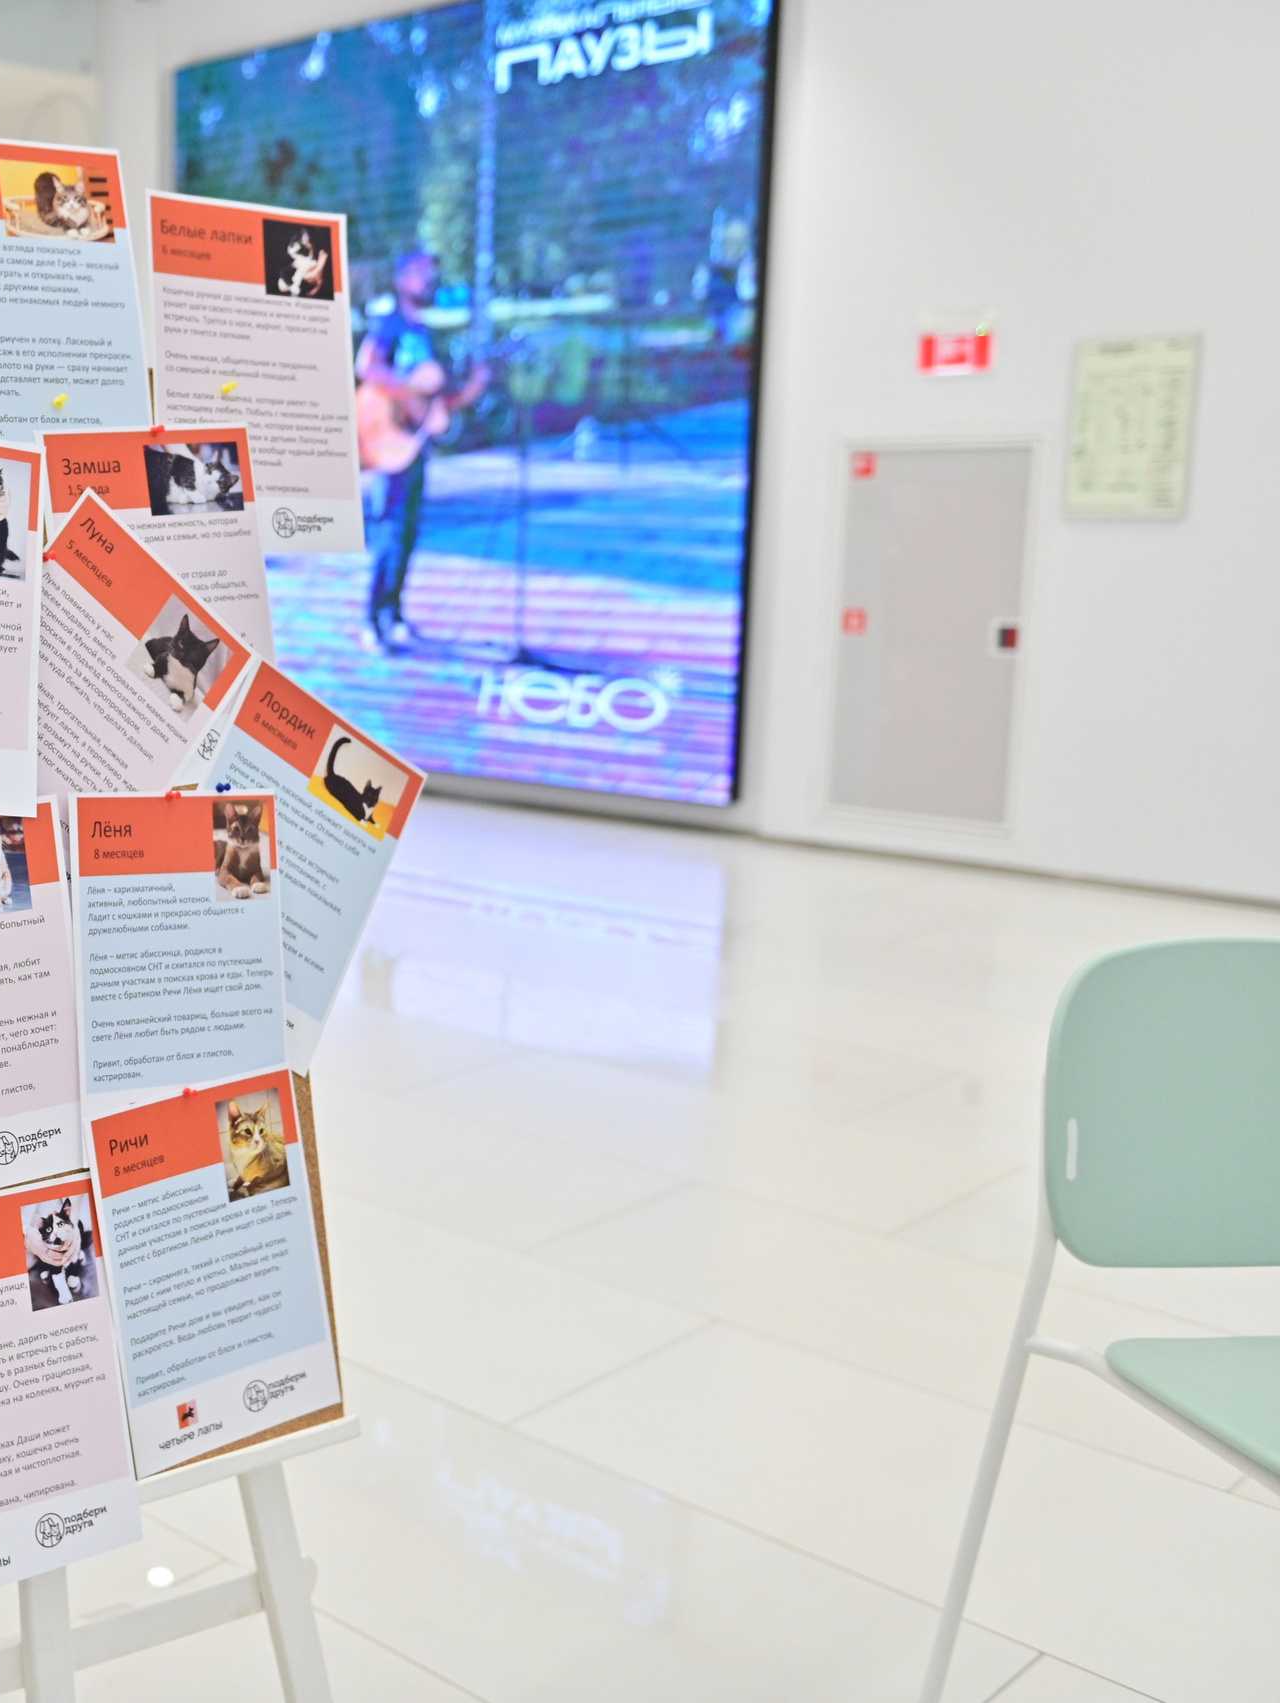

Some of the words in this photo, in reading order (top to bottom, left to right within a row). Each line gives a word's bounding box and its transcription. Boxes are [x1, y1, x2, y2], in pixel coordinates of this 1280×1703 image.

[494, 7, 715, 94] ПАУЗЫ
[61, 458, 121, 475] Замша
[79, 517, 114, 554] Луна
[66, 539, 75, 549] 5
[73, 549, 112, 587] месяцев
[259, 690, 315, 739] Лордик
[253, 712, 261, 722] 8
[260, 719, 297, 750] месяцев
[91, 821, 131, 838] Лёня
[93, 848, 100, 859] 8
[102, 850, 144, 860] месяцев
[1, 1083, 35, 1095] глистов,
[19, 1128, 61, 1143] подбери
[109, 1134, 148, 1156] Ричи
[20, 1140, 48, 1153] друга
[113, 1166, 120, 1176] 8
[123, 1155, 164, 1174] месяцев
[159, 1431, 195, 1450] четыре
[197, 1421, 222, 1436] лапы
[23, 1480, 76, 1499] чипирована.
[65, 1506, 107, 1523] подбери
[66, 1519, 93, 1534] друга
